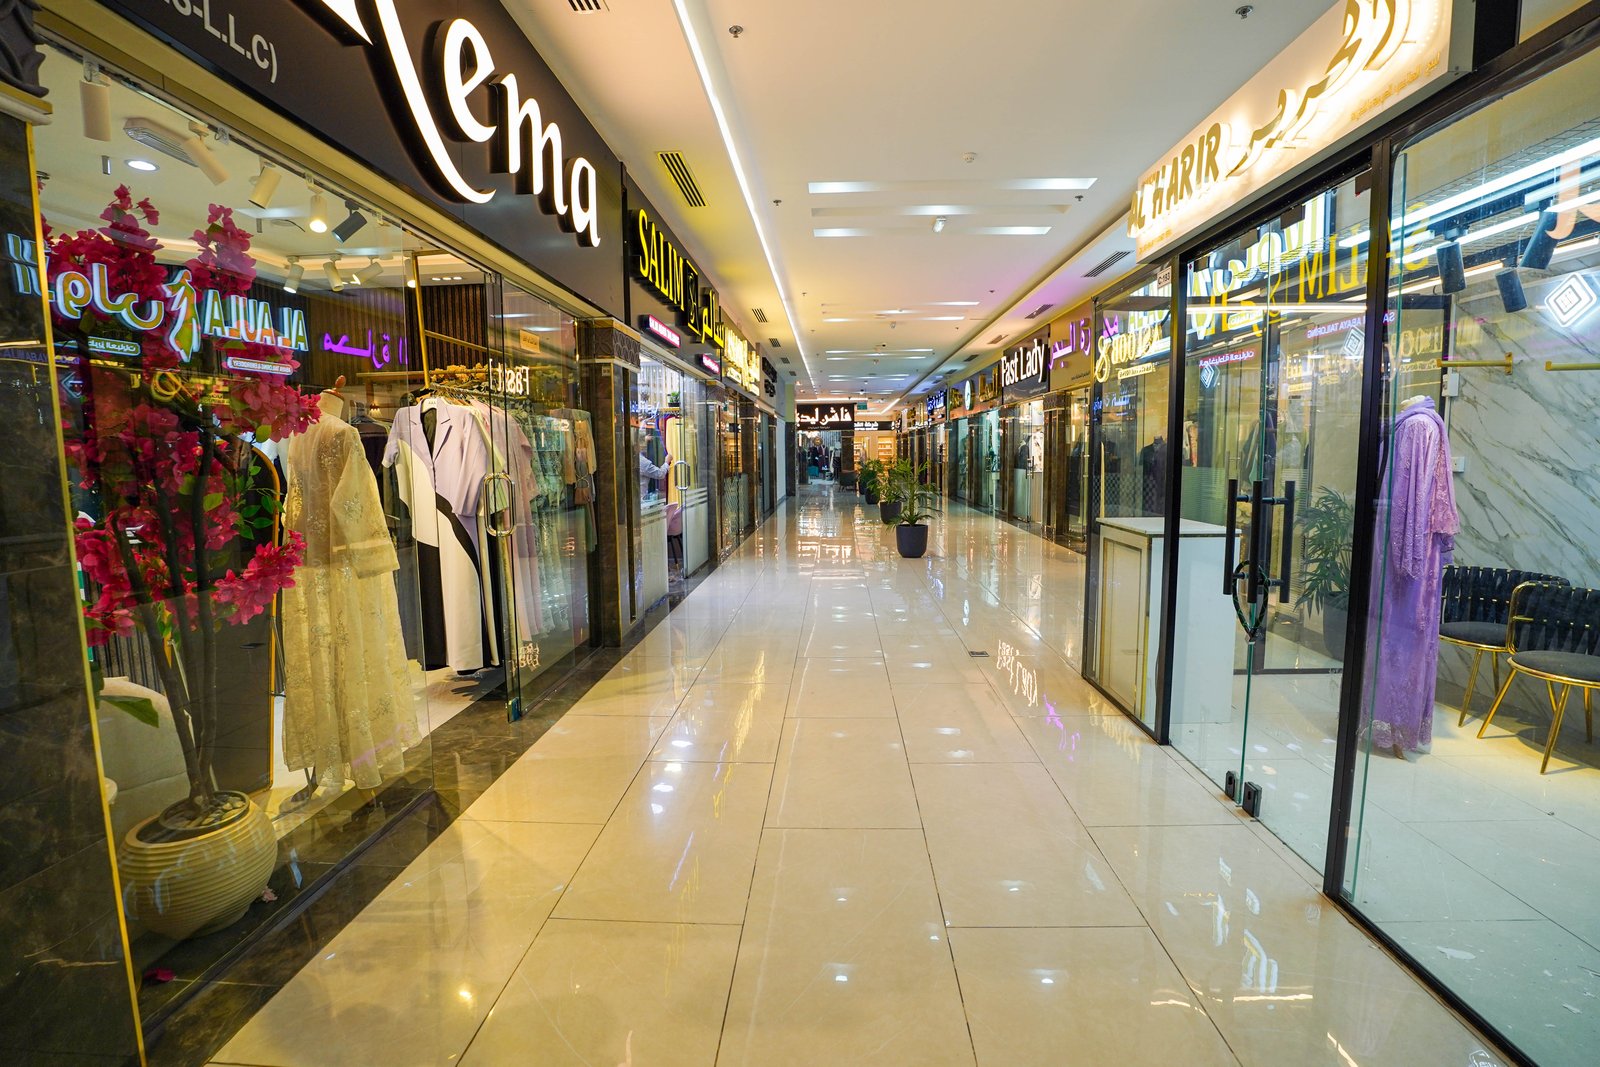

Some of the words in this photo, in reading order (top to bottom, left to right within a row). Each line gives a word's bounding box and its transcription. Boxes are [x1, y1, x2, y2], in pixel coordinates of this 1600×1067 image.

[1151, 122, 1221, 219] HARIR
[638, 208, 685, 312] SALIM
[1000, 351, 1019, 387] Fast
[1020, 338, 1045, 383] Lady
[819, 405, 852, 426] فاشن
